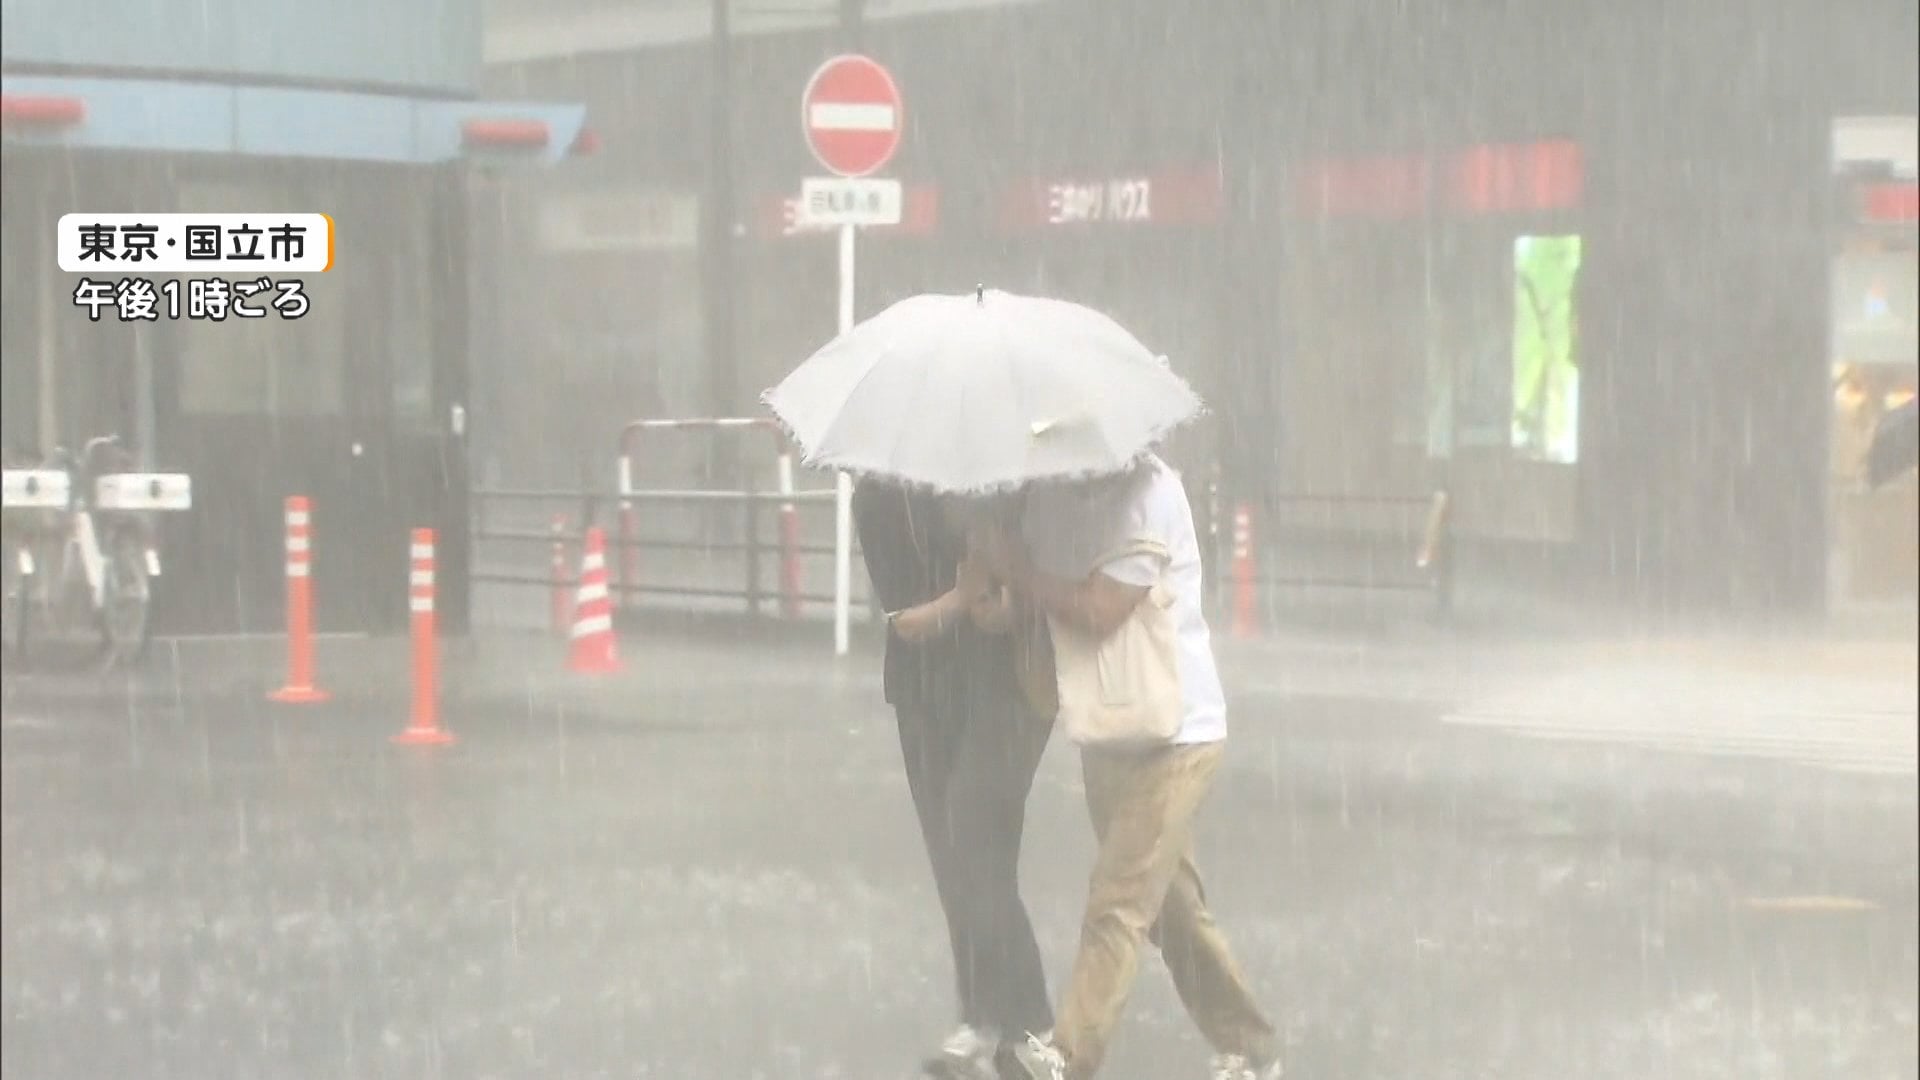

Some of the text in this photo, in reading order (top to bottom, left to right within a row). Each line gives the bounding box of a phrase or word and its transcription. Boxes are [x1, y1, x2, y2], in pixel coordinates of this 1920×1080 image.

[1048, 179, 1152, 224] 三リハウス
